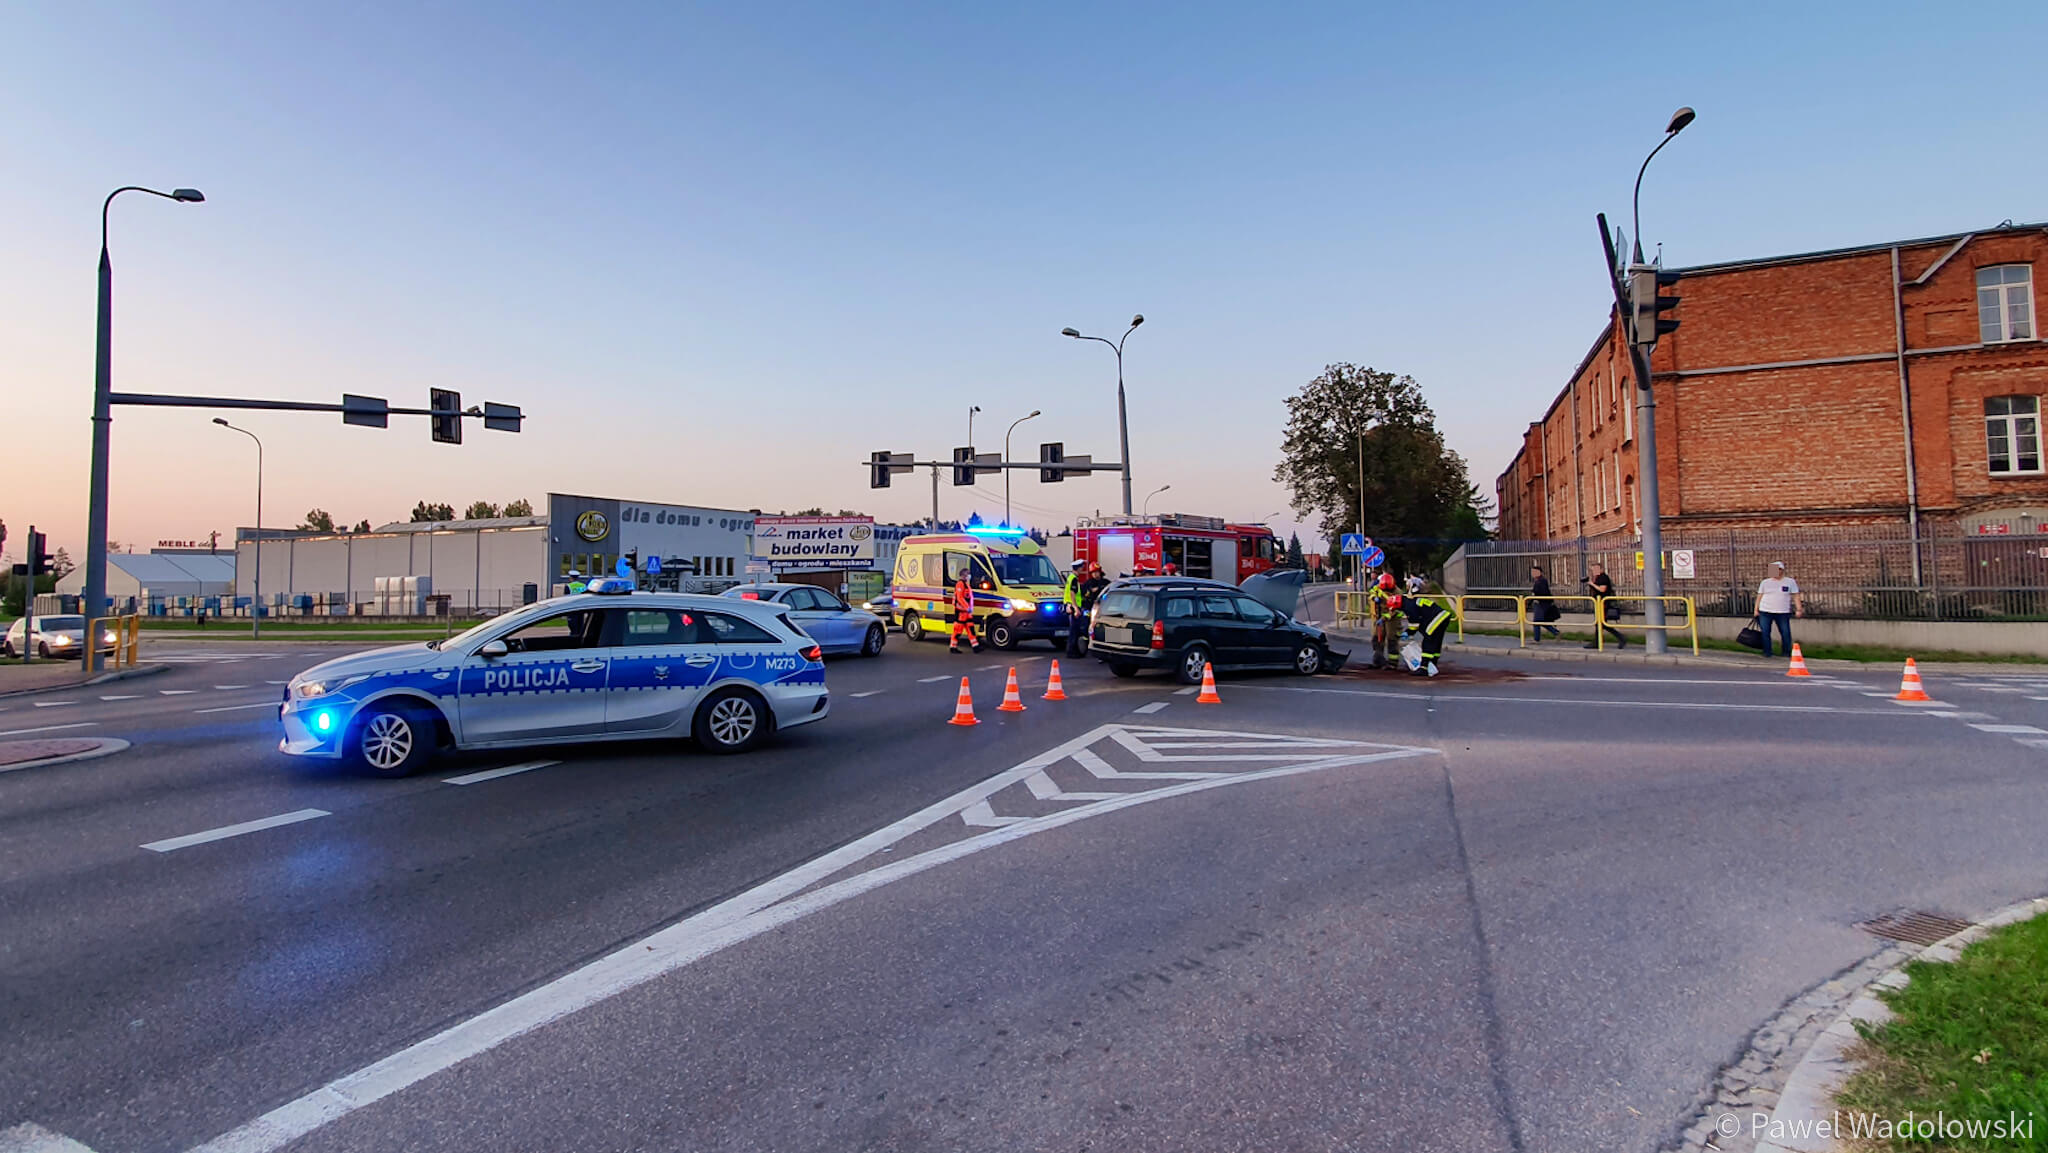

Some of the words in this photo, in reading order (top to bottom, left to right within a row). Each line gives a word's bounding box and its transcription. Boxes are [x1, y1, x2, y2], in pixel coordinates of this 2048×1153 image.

[621, 507, 650, 523] dla
[656, 509, 700, 527] domu
[720, 517, 755, 532] ogro
[787, 527, 843, 540] market
[158, 540, 196, 548] MEBLE
[771, 542, 859, 557] budowlany
[765, 657, 797, 670] M273
[484, 666, 570, 689] POLICJA
